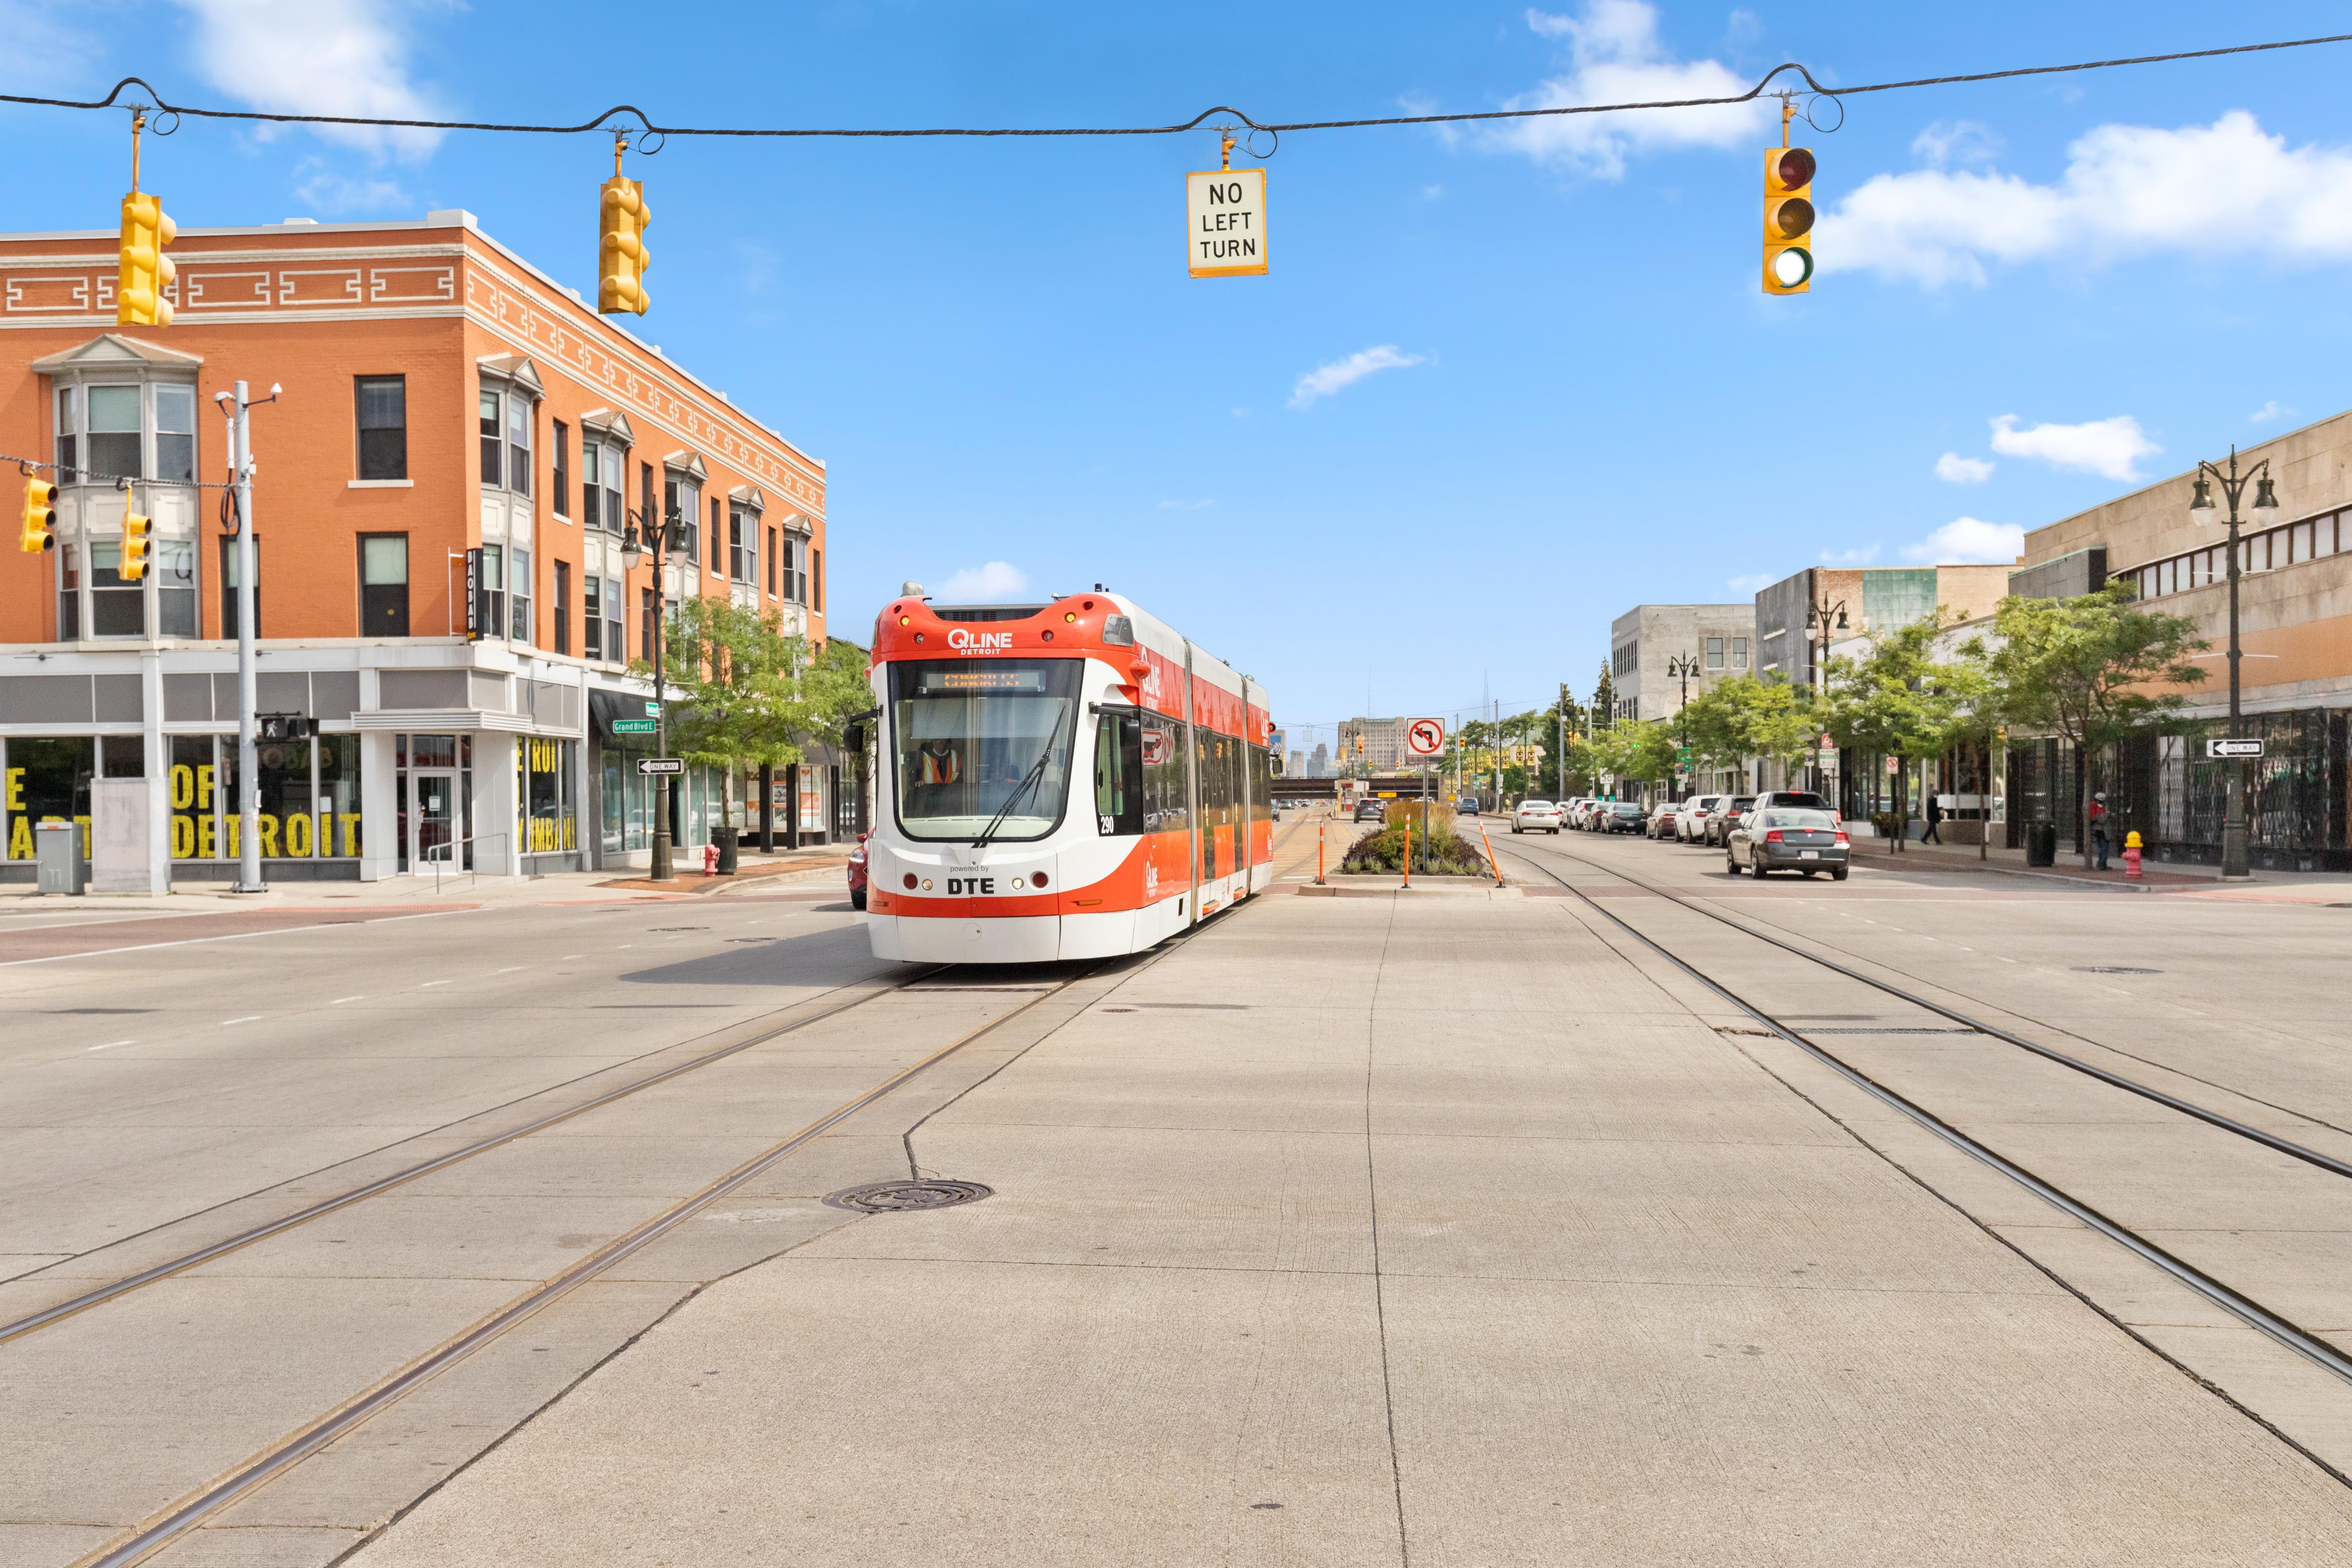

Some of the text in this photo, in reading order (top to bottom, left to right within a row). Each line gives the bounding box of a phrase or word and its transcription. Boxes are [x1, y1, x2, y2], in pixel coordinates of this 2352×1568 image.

[1210, 182, 1242, 205] NO
[1203, 212, 1252, 232] LEFT
[1200, 238, 1256, 259] TURN
[948, 629, 1012, 649] QLINE
[1141, 646, 1160, 697] QLINE
[1101, 816, 1114, 833] 290
[171, 813, 361, 859] DETROIT
[948, 878, 994, 894] DTE
